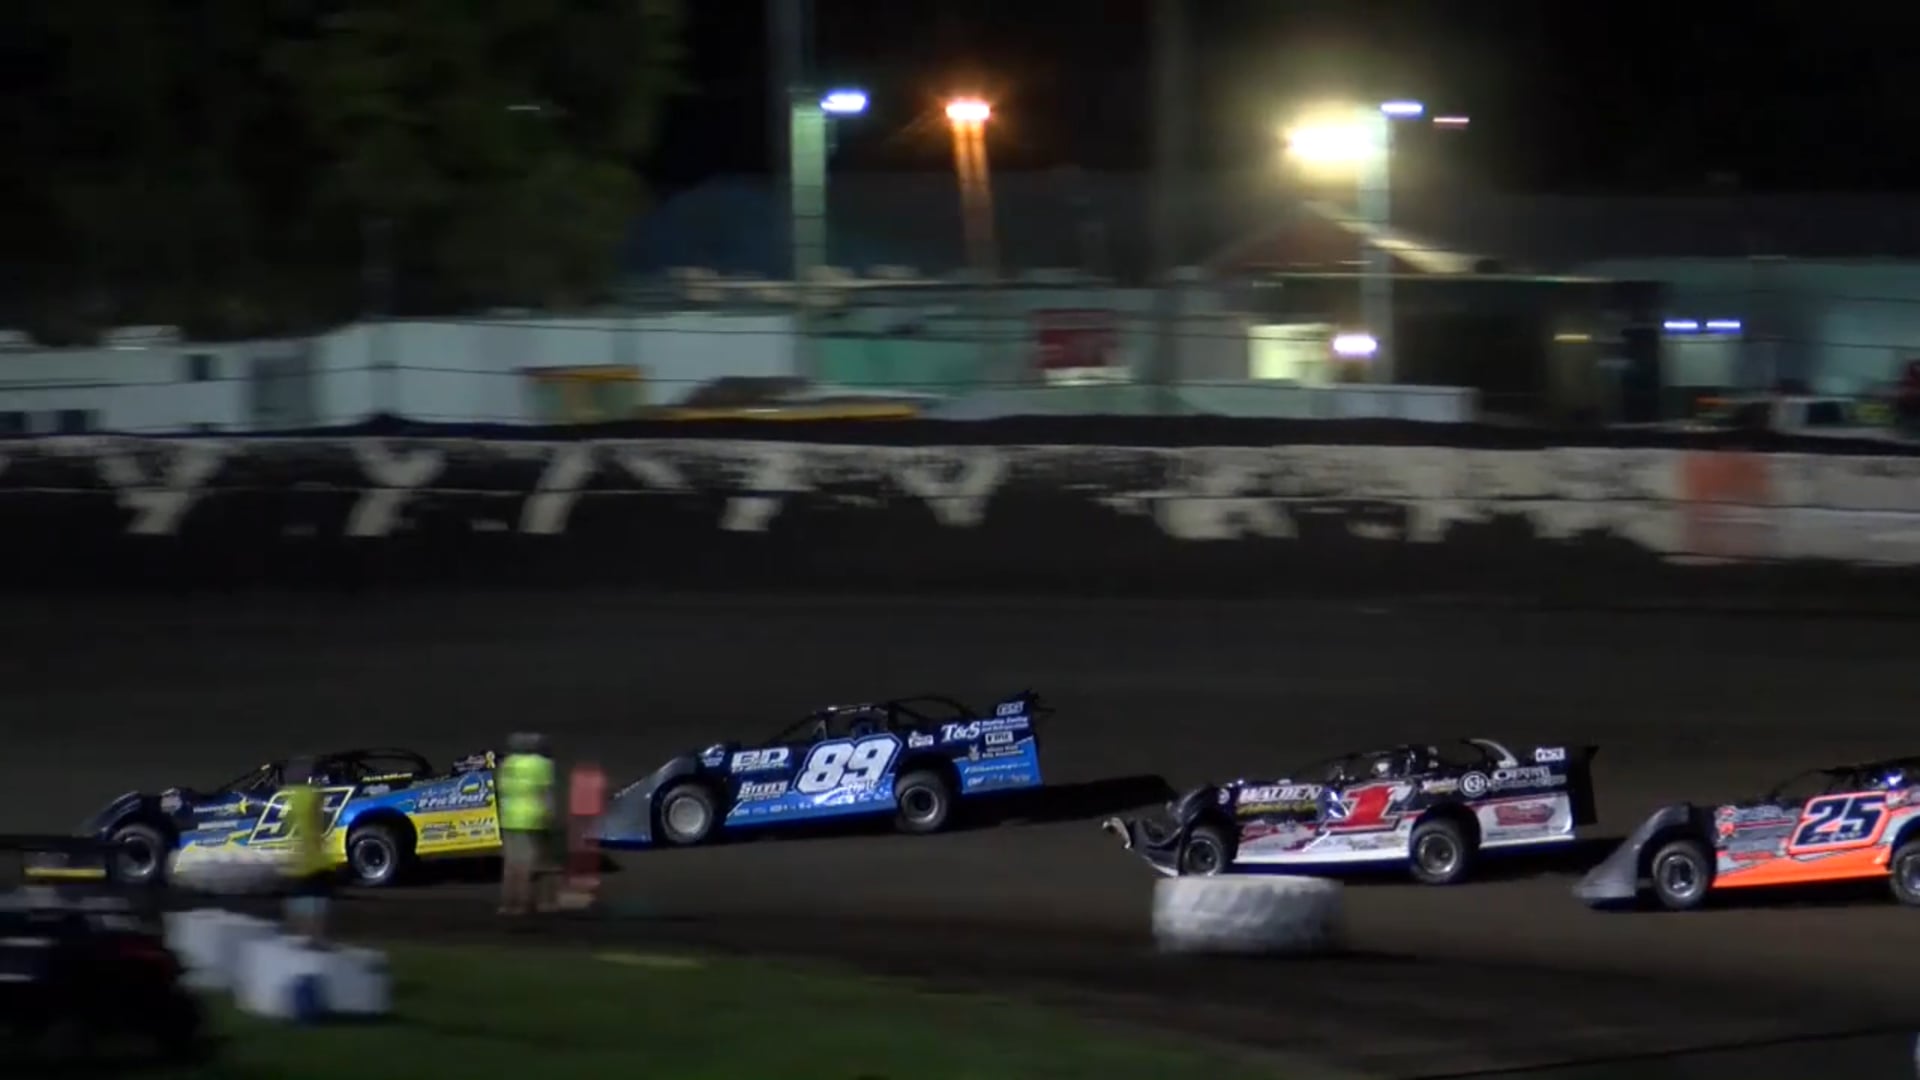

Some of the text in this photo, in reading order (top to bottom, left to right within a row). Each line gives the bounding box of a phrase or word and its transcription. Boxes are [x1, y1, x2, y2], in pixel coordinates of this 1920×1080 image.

[941, 720, 981, 743] T&S
[796, 736, 899, 794] 89
[1322, 782, 1400, 831] 1
[1792, 793, 1888, 848] 25
